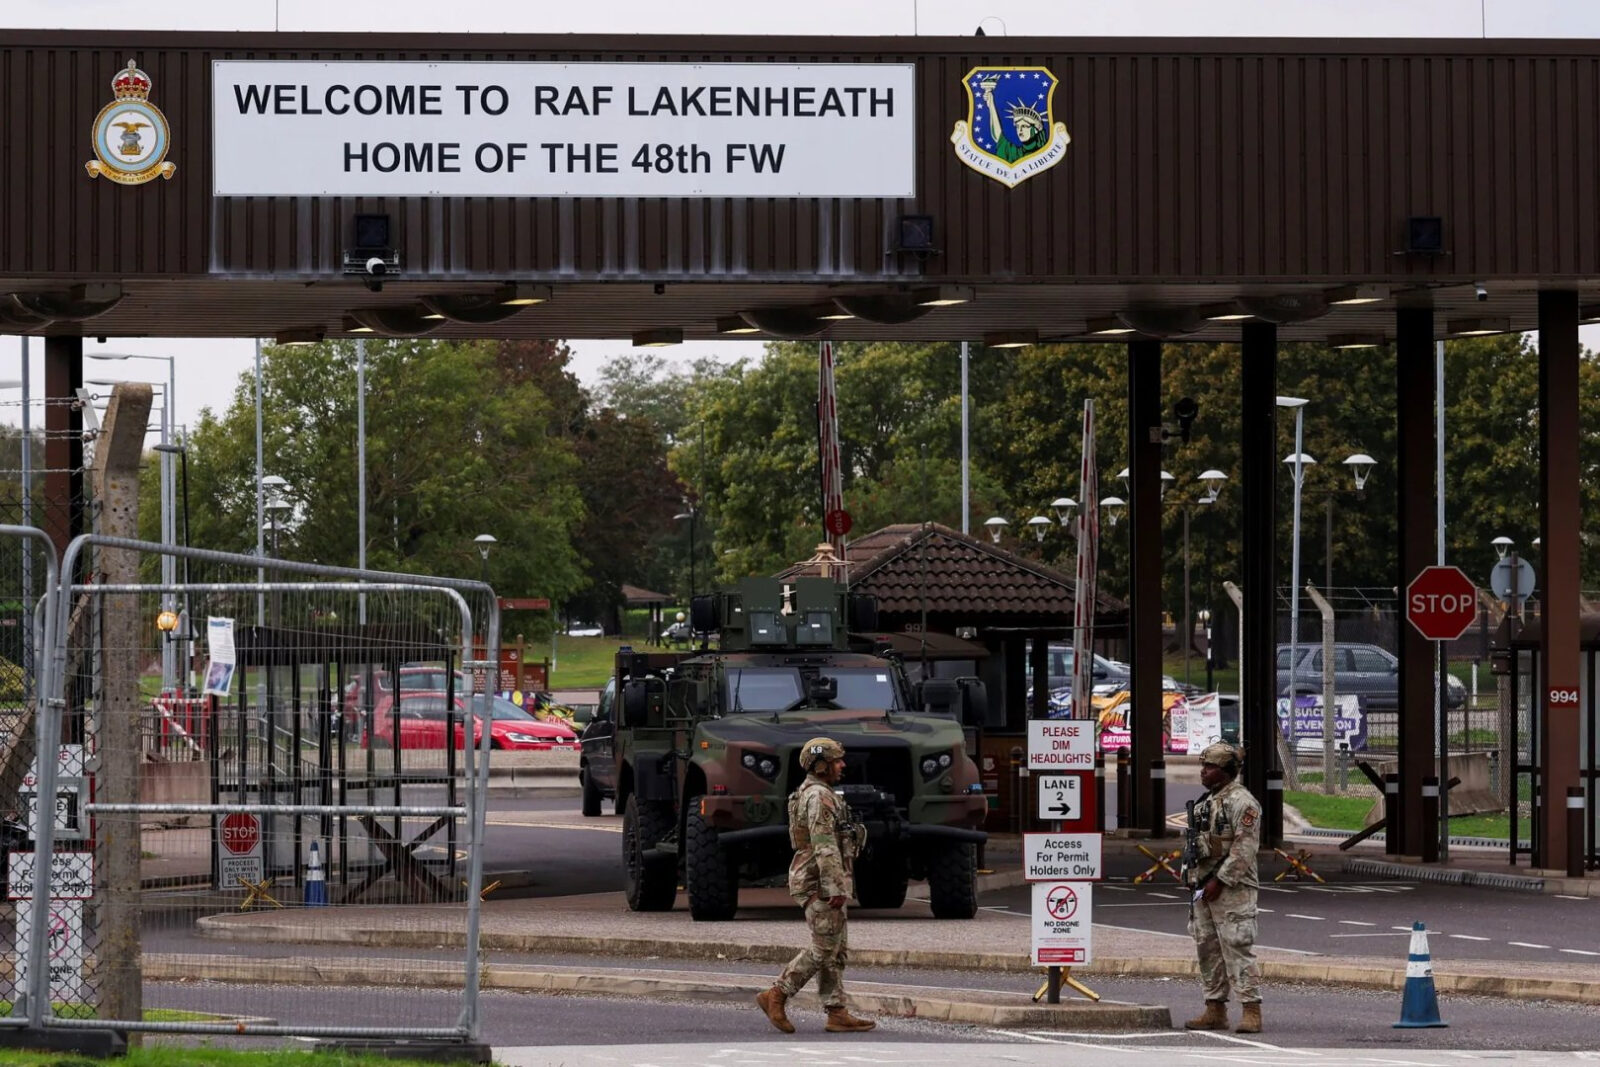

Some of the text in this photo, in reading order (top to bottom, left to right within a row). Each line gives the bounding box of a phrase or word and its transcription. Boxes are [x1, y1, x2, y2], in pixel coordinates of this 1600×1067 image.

[234, 84, 893, 117] WELCOME TO RAF LAKENHEATH
[344, 142, 785, 174] HOME OF THE 48th FW
[960, 144, 992, 169] STATUE
[996, 167, 1010, 179] DE
[1014, 168, 1027, 179] LA
[1411, 594, 1473, 613] STOP
[1550, 690, 1578, 703] 994
[1295, 708, 1339, 717] SUICIE
[1282, 720, 1352, 730] PEVENON
[1042, 727, 1080, 737] PLEASE
[810, 746, 823, 754] K9
[1052, 740, 1070, 750] DIM
[1030, 753, 1092, 764] HEADLIGHTS
[1044, 780, 1075, 789] LANE
[1056, 791, 1064, 801] 2
[224, 826, 256, 839] STOP
[1044, 838, 1082, 849] Access
[1036, 851, 1089, 862] For Permit
[1030, 864, 1096, 877] Holders Only
